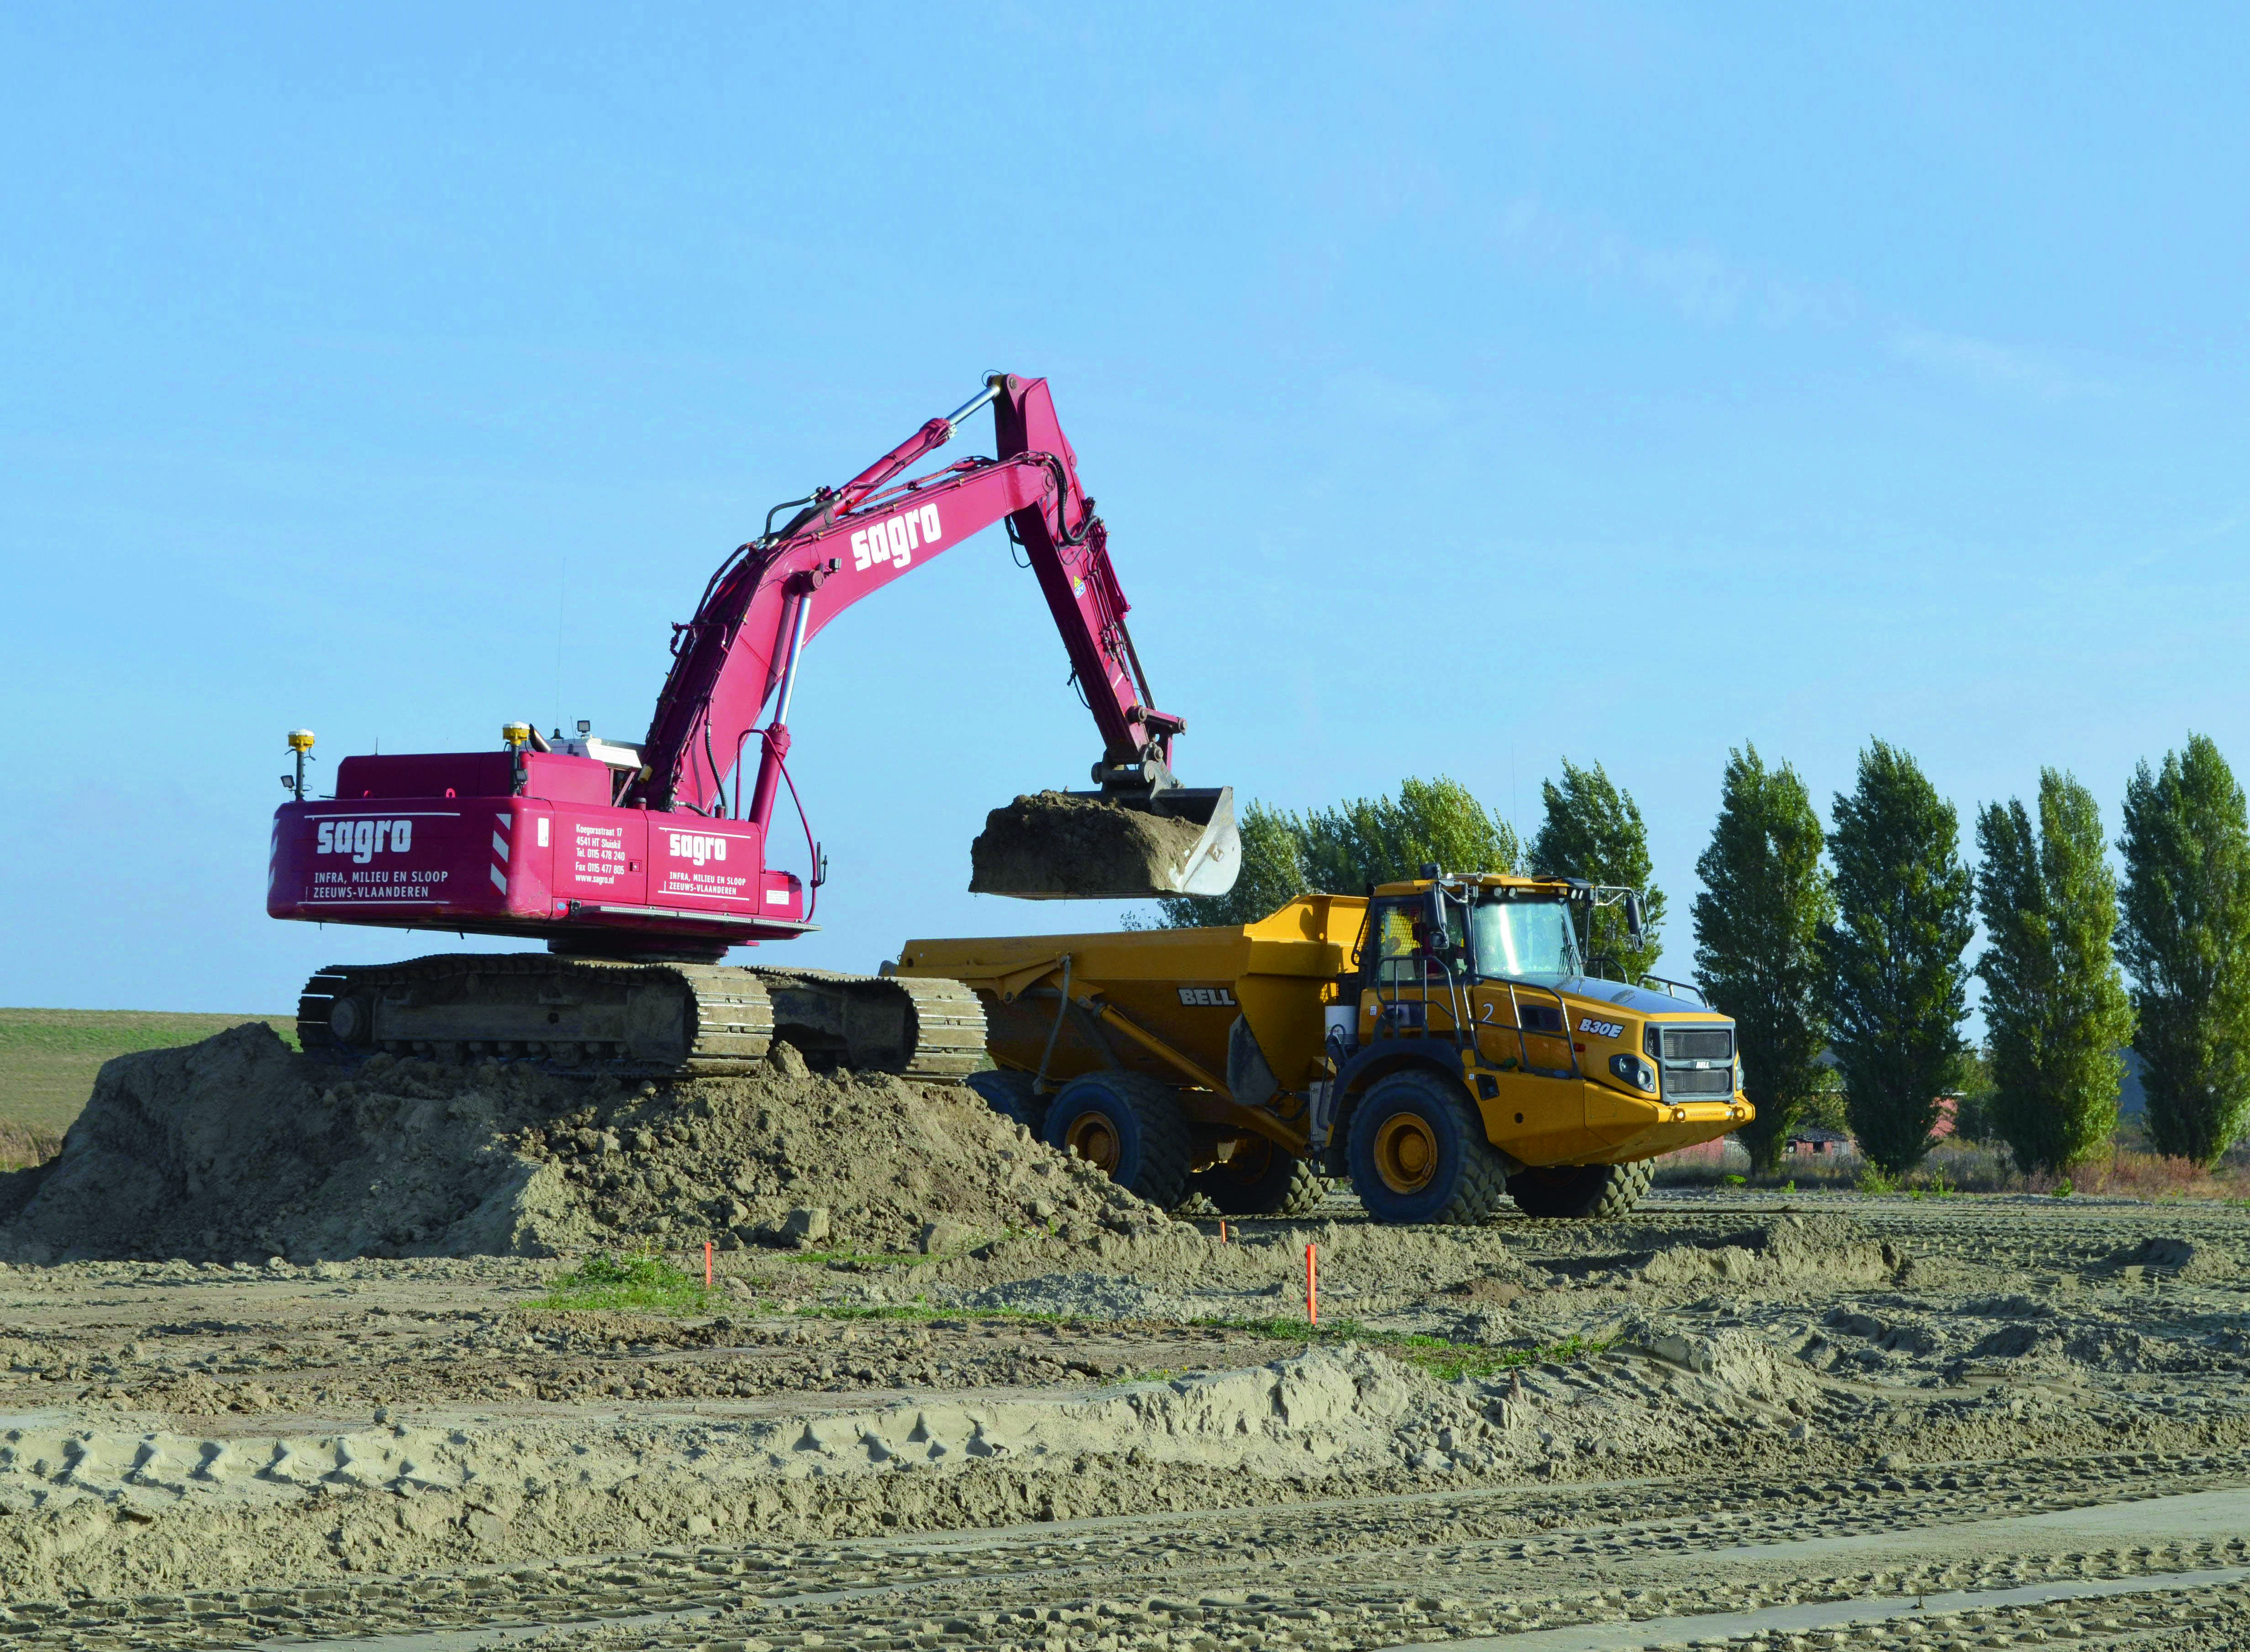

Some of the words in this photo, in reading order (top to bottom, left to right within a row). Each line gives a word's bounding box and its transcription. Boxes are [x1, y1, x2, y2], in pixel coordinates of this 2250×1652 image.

[851, 503, 941, 572] sagro
[576, 823, 615, 836] Koegorsstraat
[616, 828, 622, 837] 17
[317, 820, 412, 863] sagro
[576, 836, 590, 846] 4541
[592, 838, 600, 847] HT
[601, 839, 621, 849] Sluiskil
[587, 849, 599, 859] 0115
[601, 850, 612, 860] 478
[614, 851, 625, 861] 240
[670, 834, 726, 866] sagro
[576, 861, 586, 871] Fax
[588, 863, 599, 873] 0115
[601, 864, 612, 874] 477
[613, 865, 625, 875] 805
[314, 872, 347, 884] INFRA,
[352, 871, 389, 883] MILIEU
[394, 871, 406, 882] EN
[412, 871, 448, 882] SLOOP
[575, 875, 614, 885] www.sagro.nl
[669, 871, 691, 881] INFRA,
[693, 874, 715, 883] MILIEU
[717, 876, 725, 884] EN
[726, 876, 746, 886] SLOOP
[313, 886, 428, 898] ZEEUWS-VLAANDEREN
[669, 882, 736, 895] ZEEUWS-VLAANDEREN
[1178, 989, 1236, 1005] BELL
[1482, 1003, 1493, 1023] 2
[1578, 1018, 1623, 1038] B30E
